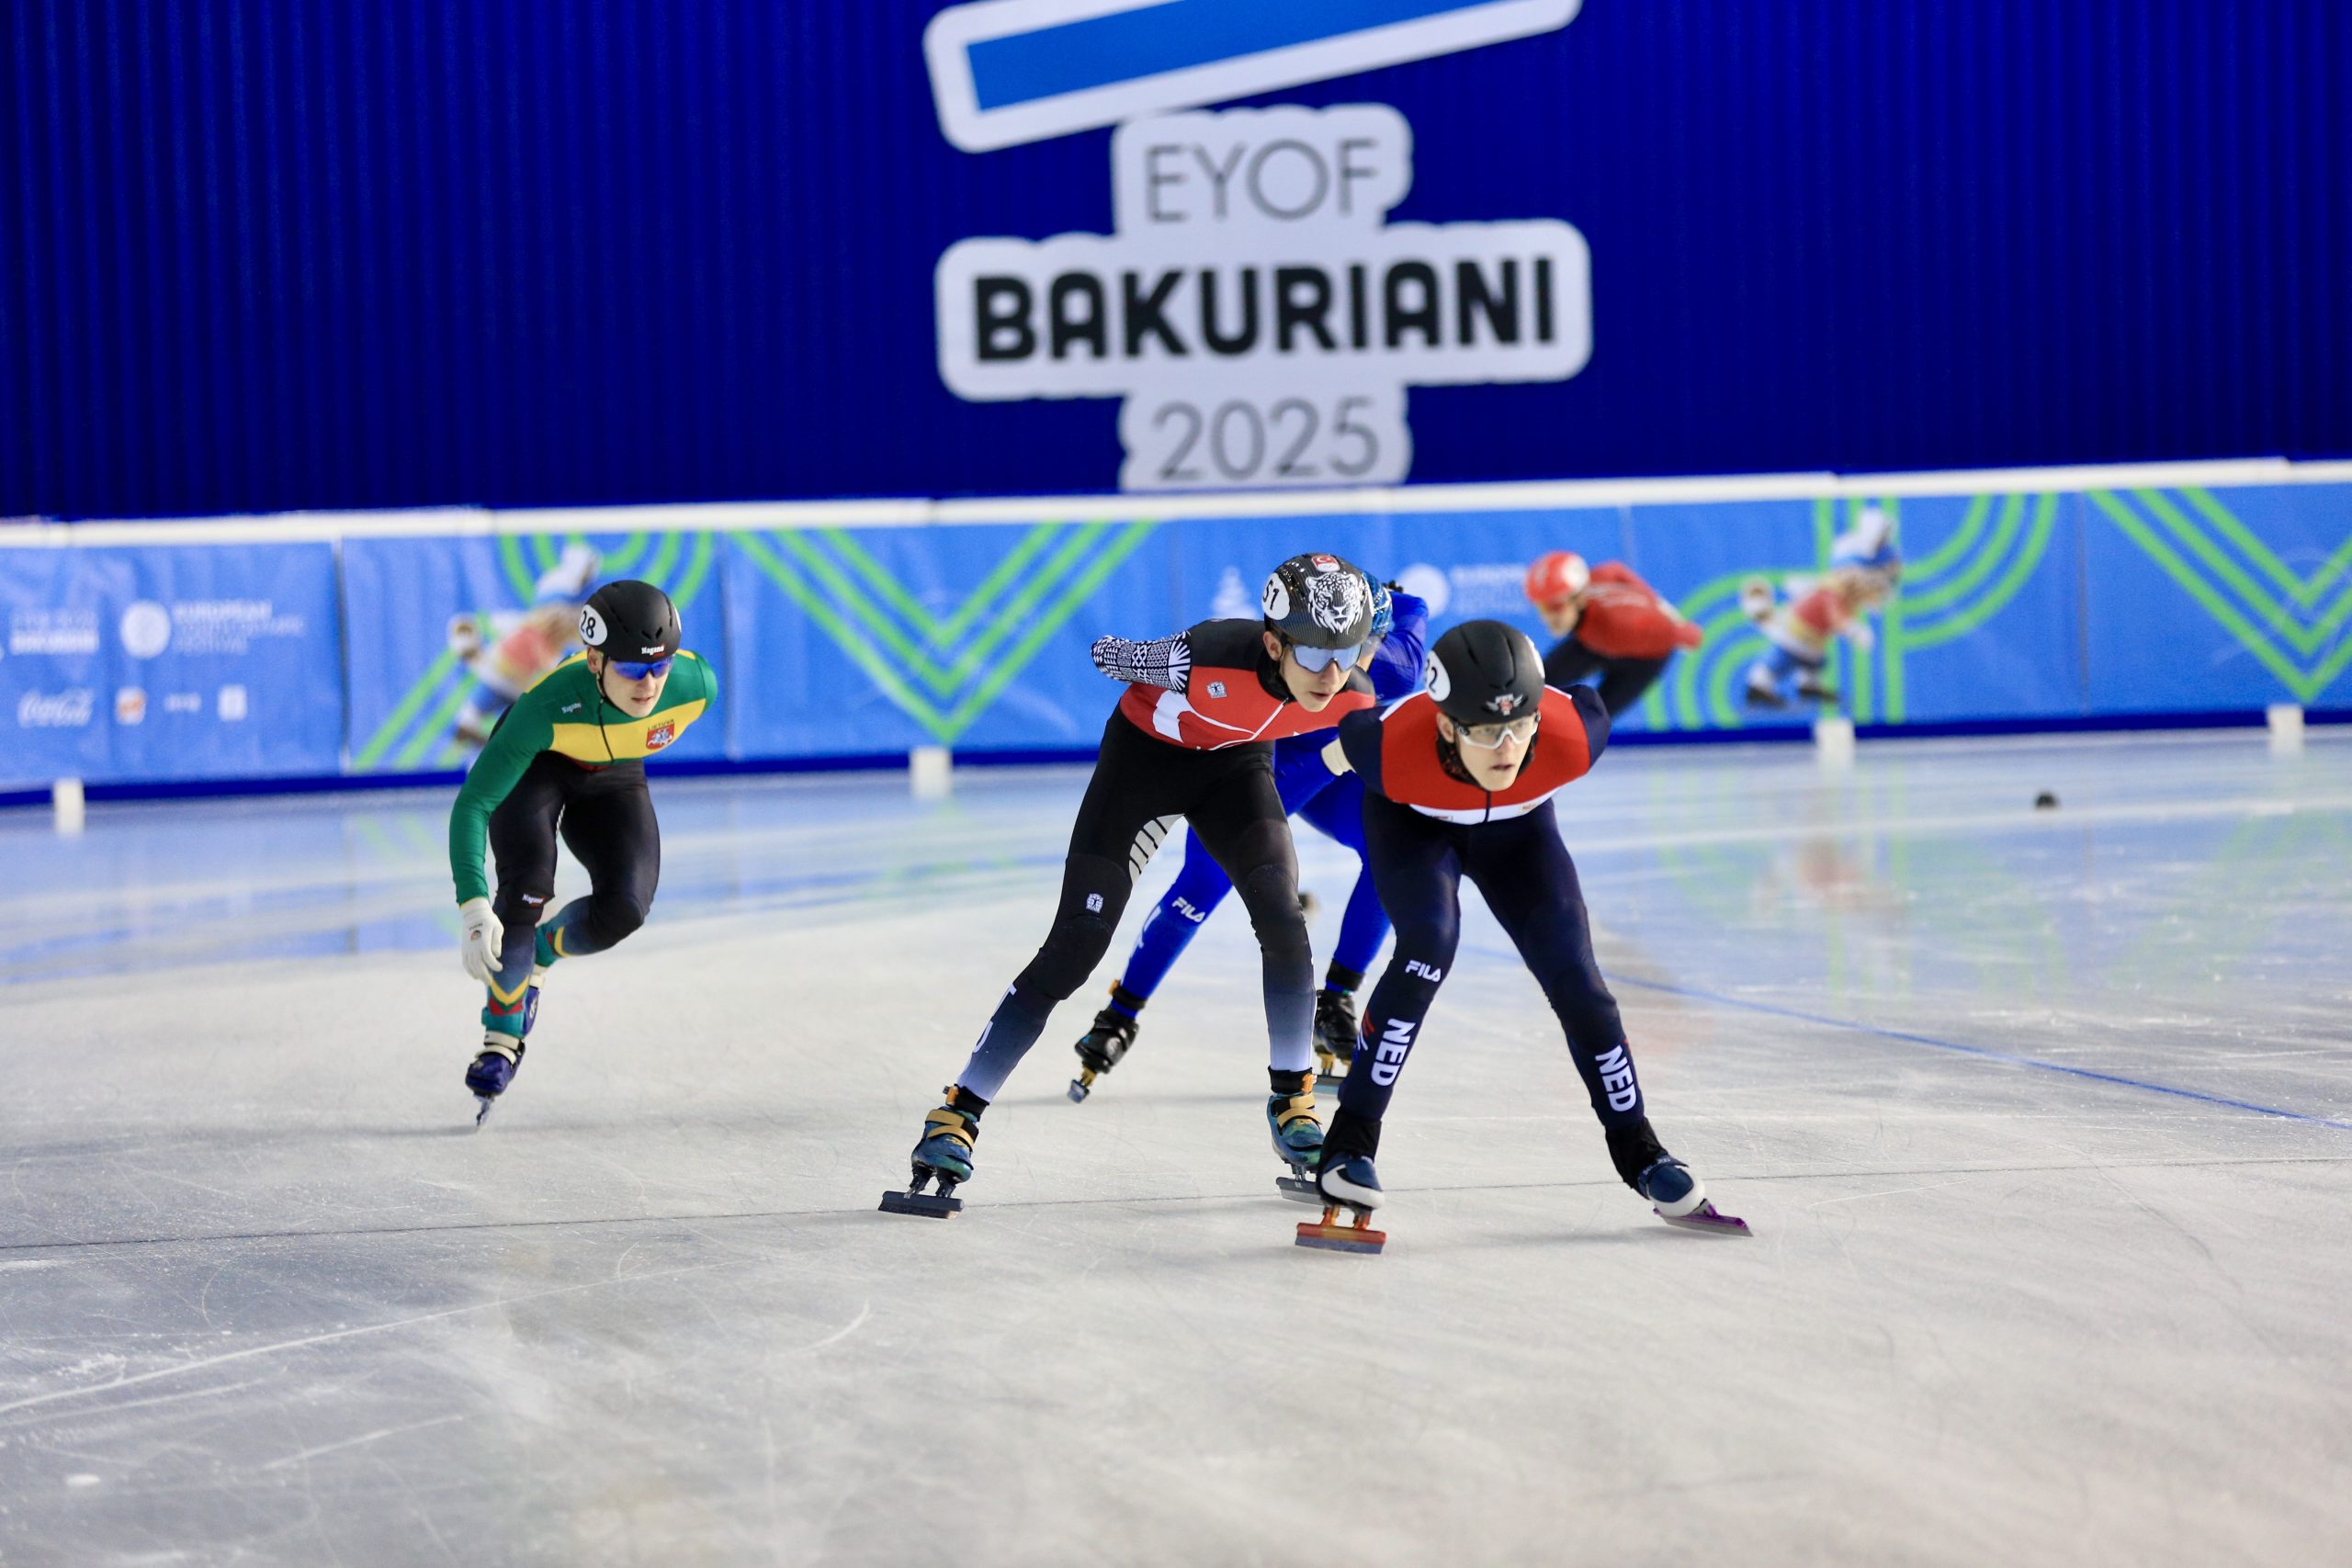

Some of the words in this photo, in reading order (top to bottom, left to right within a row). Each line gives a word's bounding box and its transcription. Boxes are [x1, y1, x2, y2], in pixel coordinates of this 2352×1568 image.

[1145, 138, 1378, 222] EYOF
[973, 257, 1555, 363] BAKURIANI
[1152, 397, 1379, 481] 2025
[580, 610, 596, 639] 28
[1171, 897, 1205, 922] FILA
[1405, 959, 1442, 982] FILA
[1371, 1018, 1417, 1087] NED
[1595, 1044, 1637, 1112] NED
